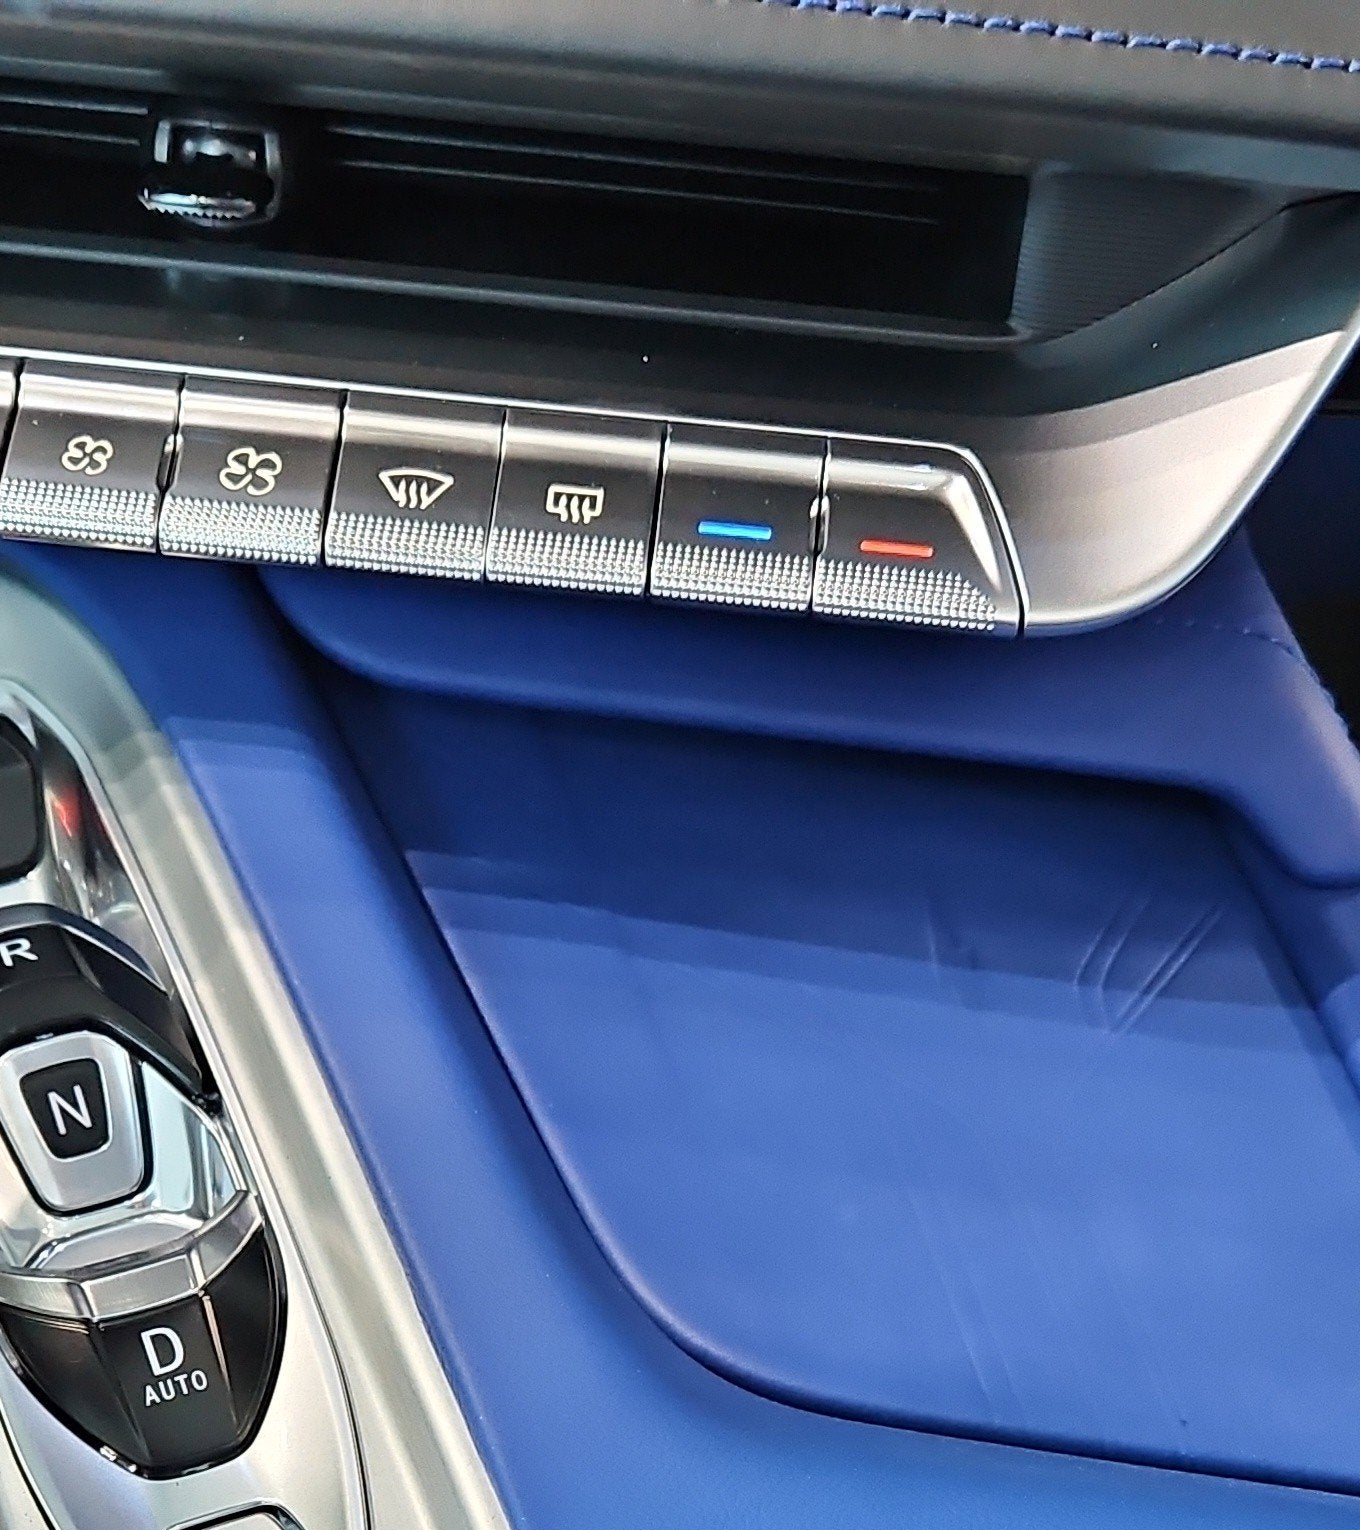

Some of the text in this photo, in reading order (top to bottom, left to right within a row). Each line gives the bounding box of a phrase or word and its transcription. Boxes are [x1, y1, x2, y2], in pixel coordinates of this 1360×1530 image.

[47, 1084, 92, 1136] N
[141, 1326, 185, 1376] D
[144, 1370, 208, 1406] AUTO
